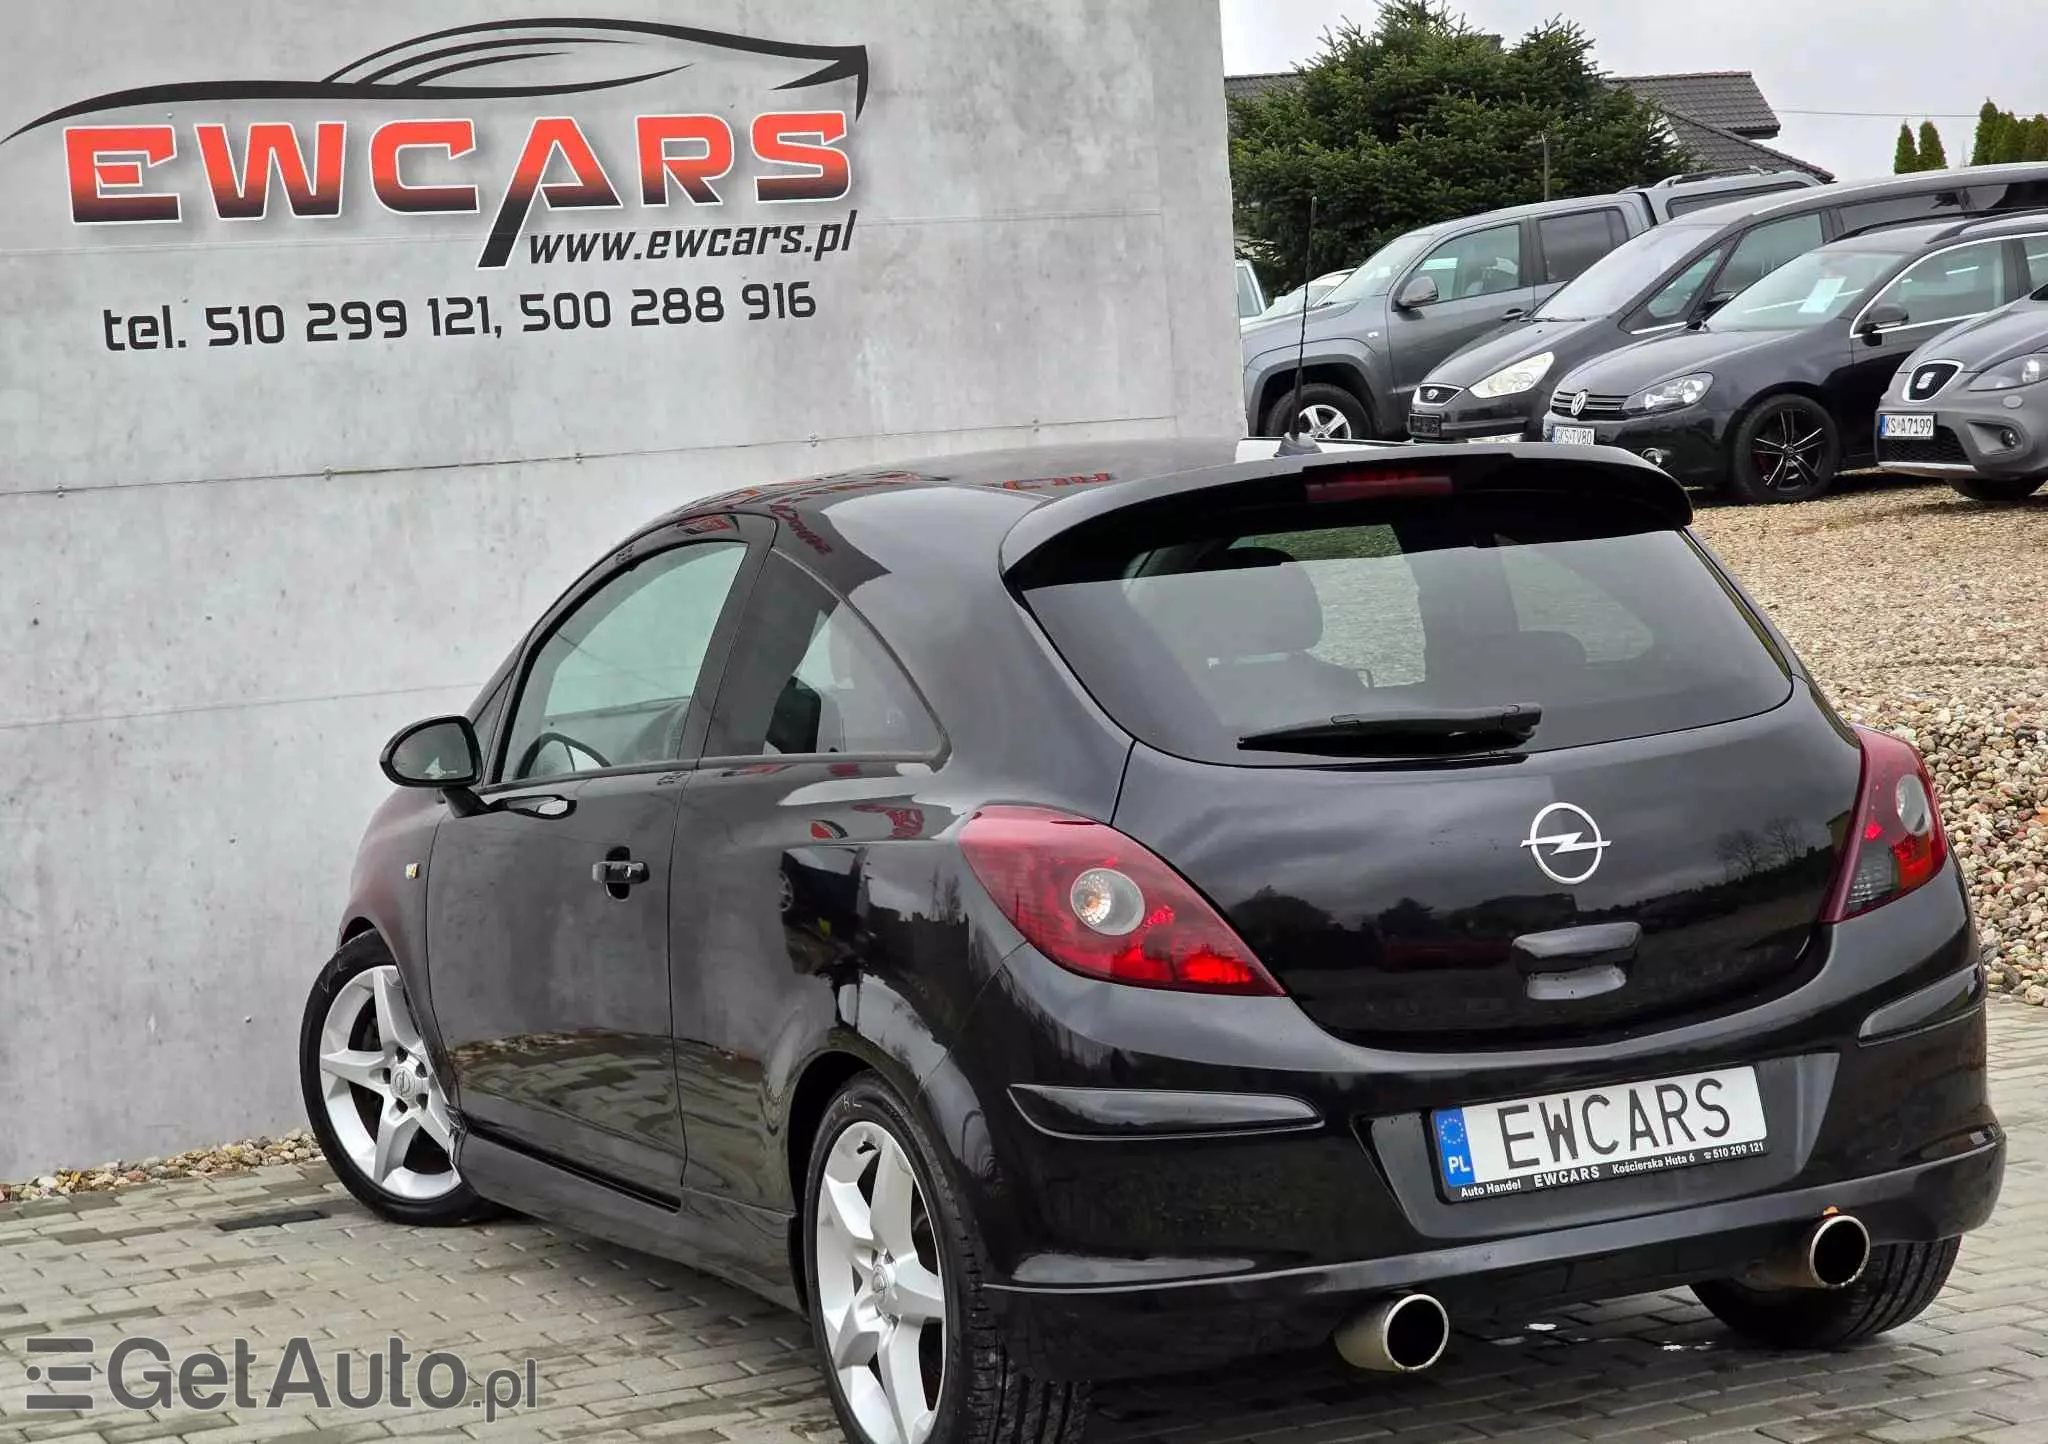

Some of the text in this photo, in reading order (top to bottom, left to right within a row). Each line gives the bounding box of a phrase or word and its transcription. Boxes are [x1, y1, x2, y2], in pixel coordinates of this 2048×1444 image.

[63, 110, 853, 269] EWCARS
[529, 209, 857, 265] www.ewcars.pl
[103, 281, 816, 351] tel. 510 299 121, 500 288 916
[1497, 1078, 1731, 1170] EWCARS
[1448, 1155, 1471, 1175] PL
[1461, 1185, 1485, 1198] Auto
[1486, 1178, 1521, 1195] Handel
[1533, 1165, 1600, 1188] EWCARS
[1665, 1154, 1688, 1167] Huta
[1689, 1153, 1696, 1163] 6
[1712, 1147, 1729, 1159] 510
[1730, 1144, 1747, 1157] 299
[1749, 1141, 1764, 1153] 121
